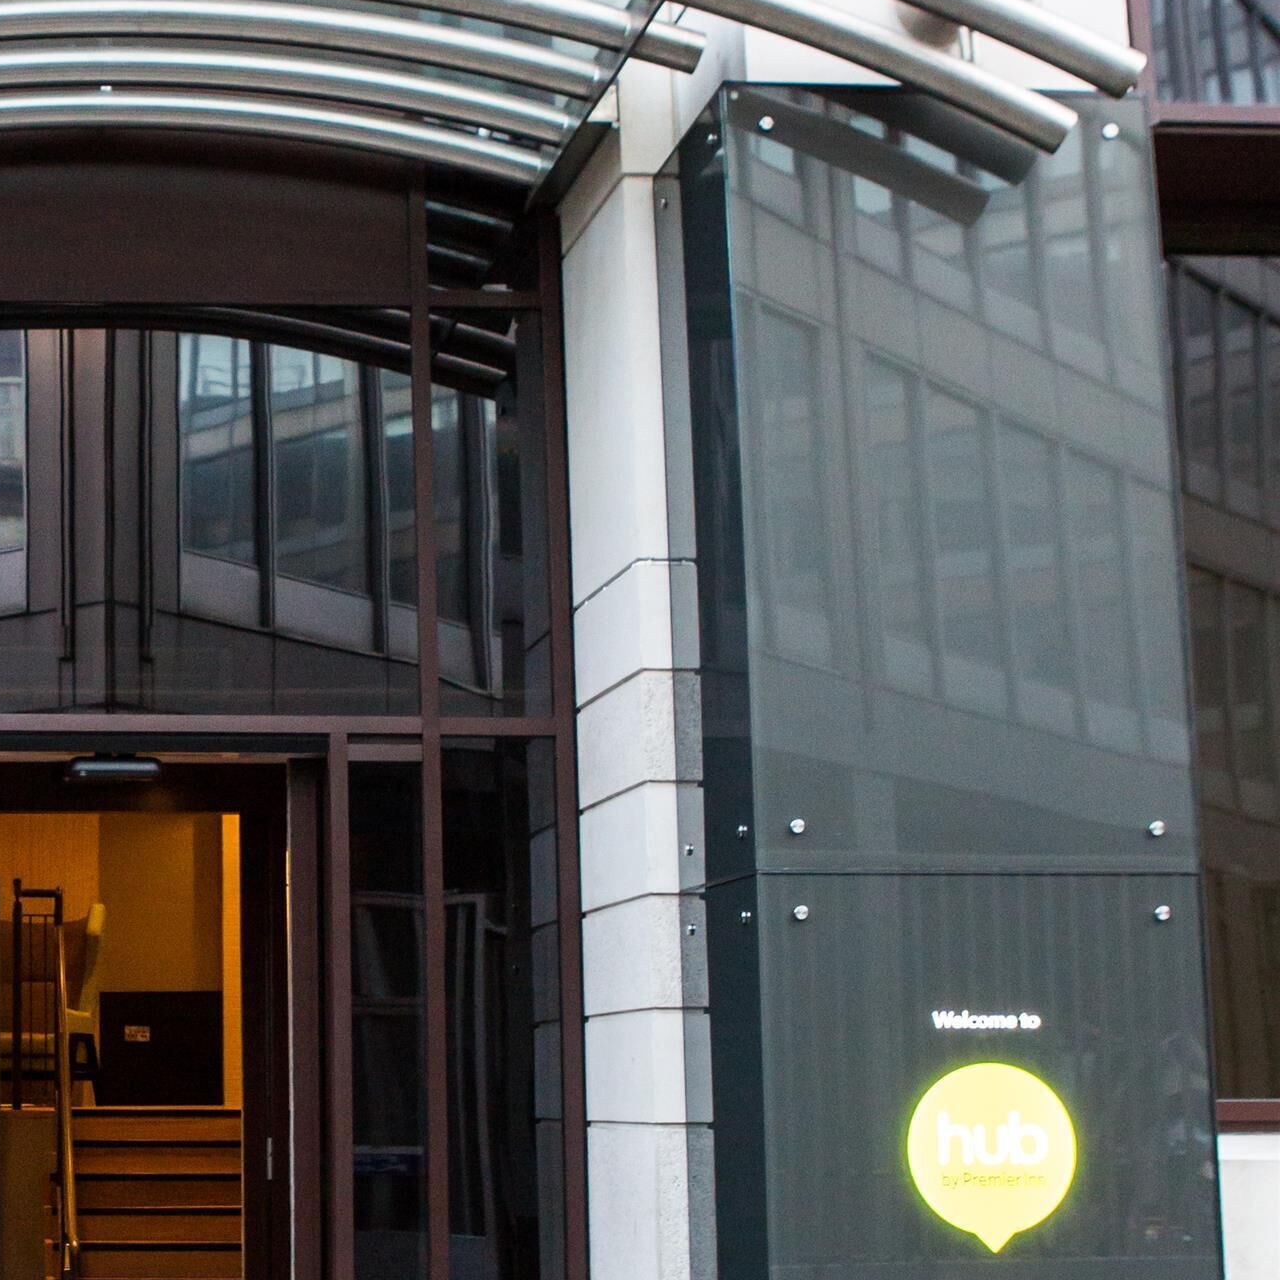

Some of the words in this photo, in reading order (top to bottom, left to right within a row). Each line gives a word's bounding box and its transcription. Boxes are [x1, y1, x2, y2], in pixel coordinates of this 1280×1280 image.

[931, 1009, 1018, 1029] Welcome
[1019, 1012, 1041, 1029] to
[937, 1110, 1048, 1165] hub
